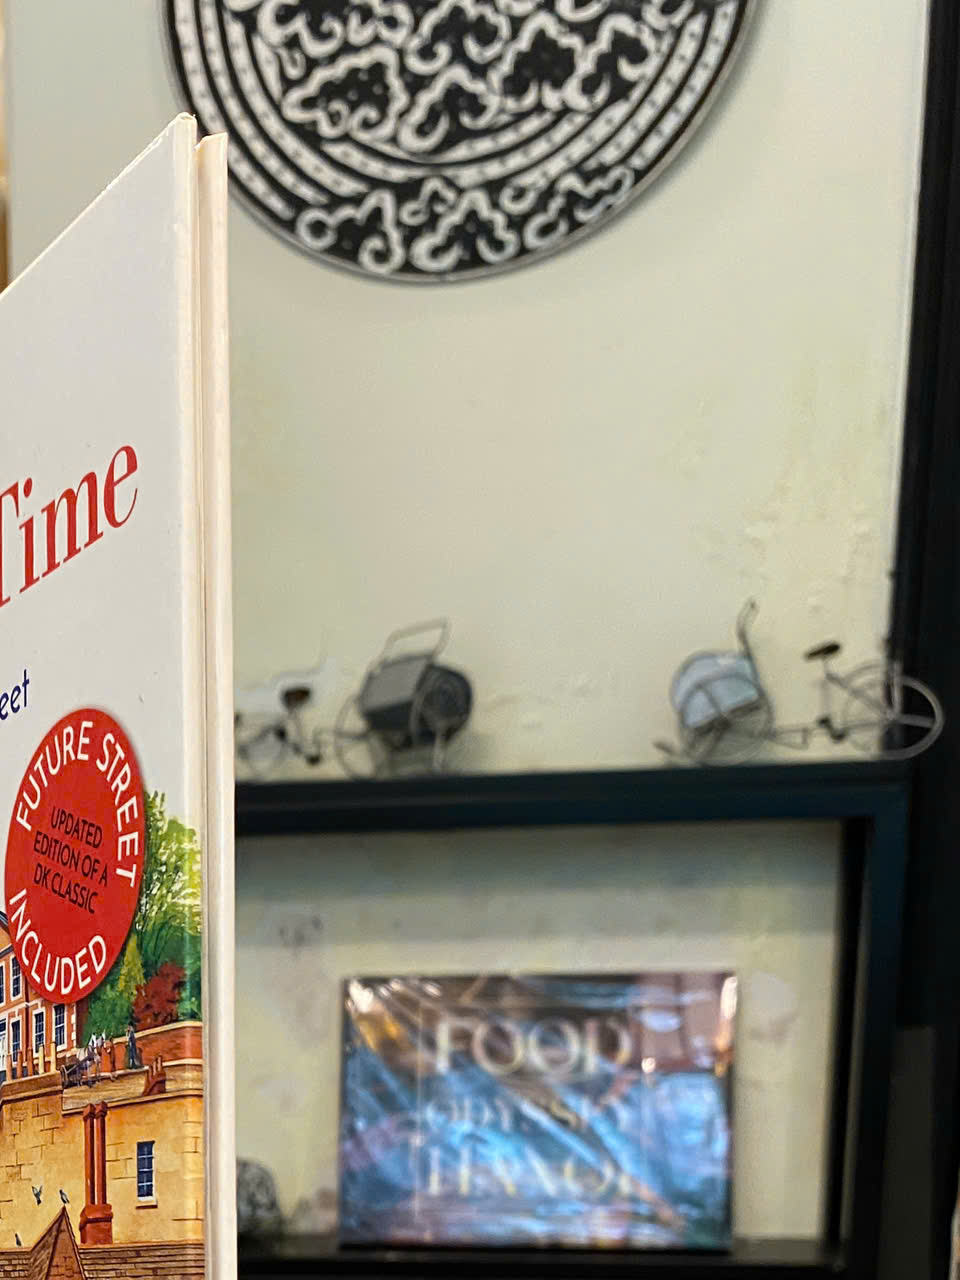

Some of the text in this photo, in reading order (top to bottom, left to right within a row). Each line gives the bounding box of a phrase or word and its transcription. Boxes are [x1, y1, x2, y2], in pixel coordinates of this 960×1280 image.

[16, 720, 139, 888] FUTURE STREET
[50, 805, 103, 849] UPDATED
[33, 830, 108, 888] EDITION OF A
[33, 863, 99, 914] DK CLASSIC
[9, 888, 107, 995] INCLUDED
